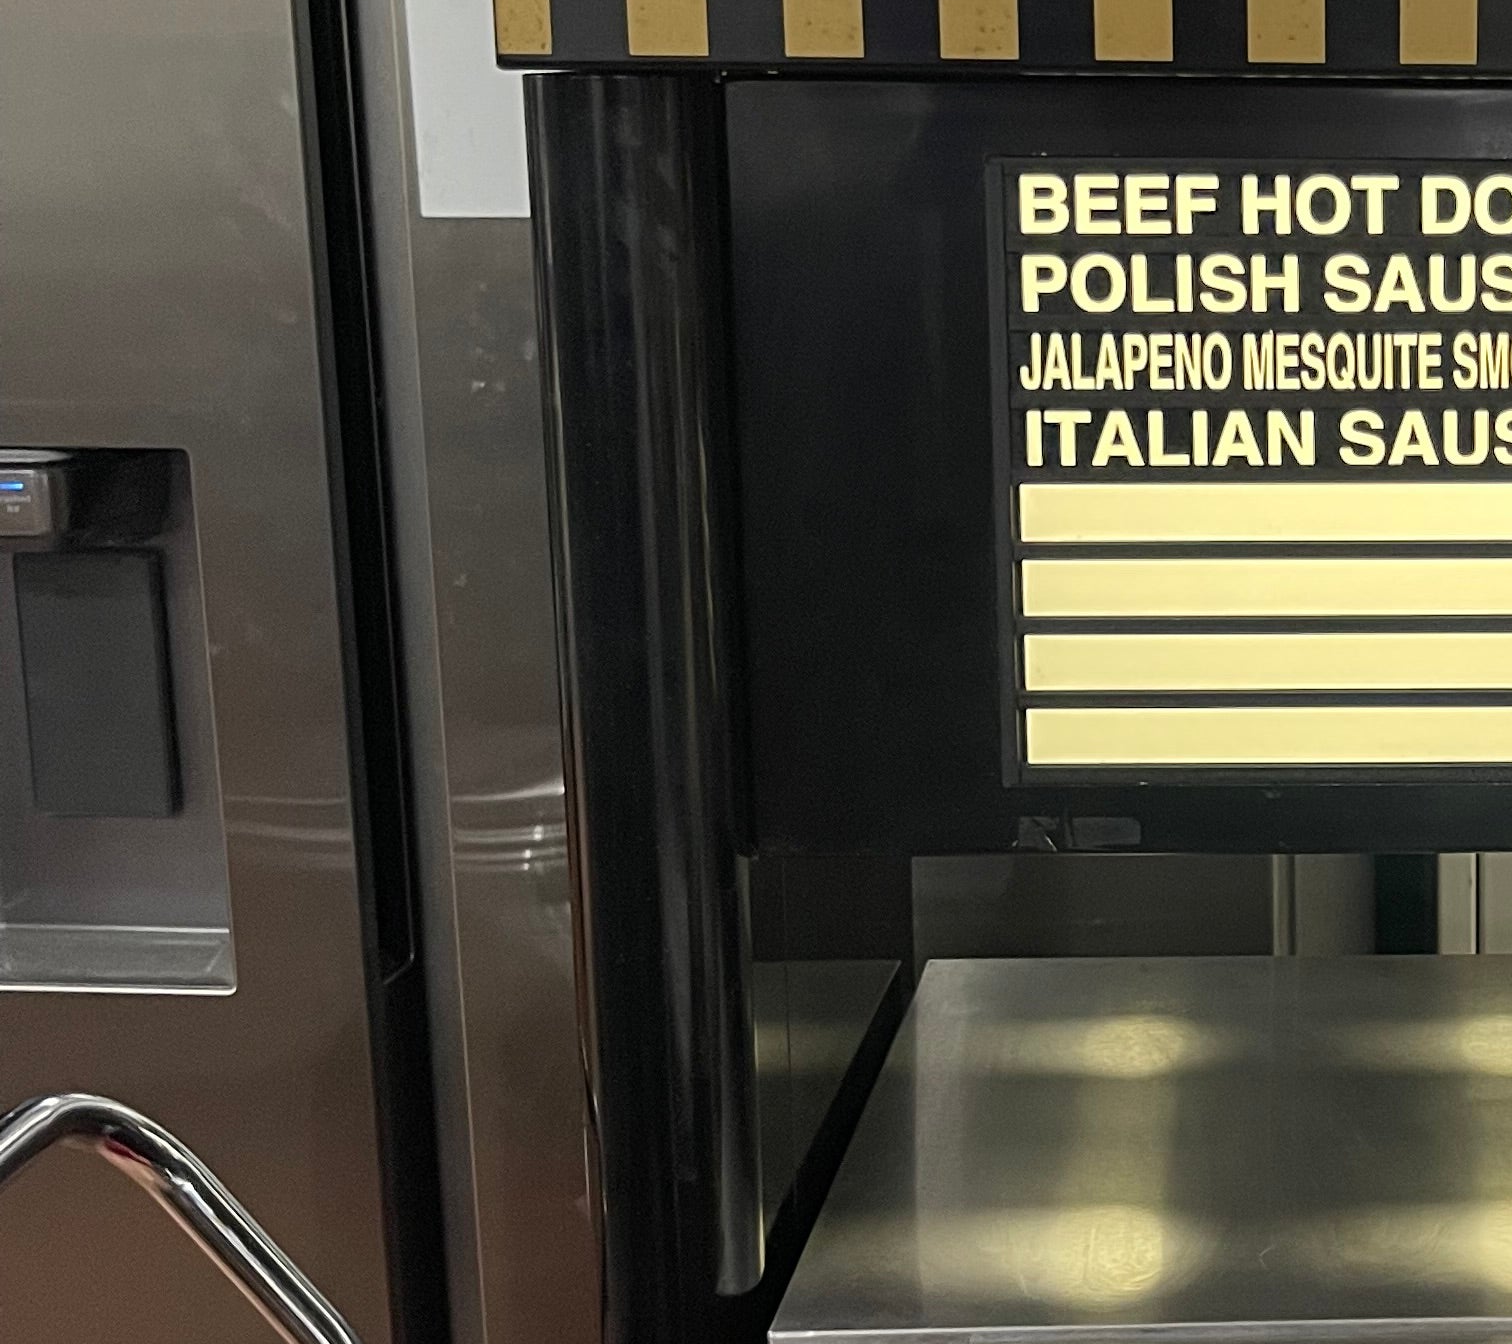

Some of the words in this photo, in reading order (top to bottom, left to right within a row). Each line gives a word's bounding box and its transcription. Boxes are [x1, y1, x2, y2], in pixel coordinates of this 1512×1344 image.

[1018, 173, 1220, 235] BEEF
[1241, 173, 1400, 236] HOT
[1020, 251, 1300, 314] POLISH
[1019, 331, 1233, 391] JALAPENO
[1242, 329, 1444, 391] MESQUITE
[1025, 409, 1316, 467] ITALIAN
